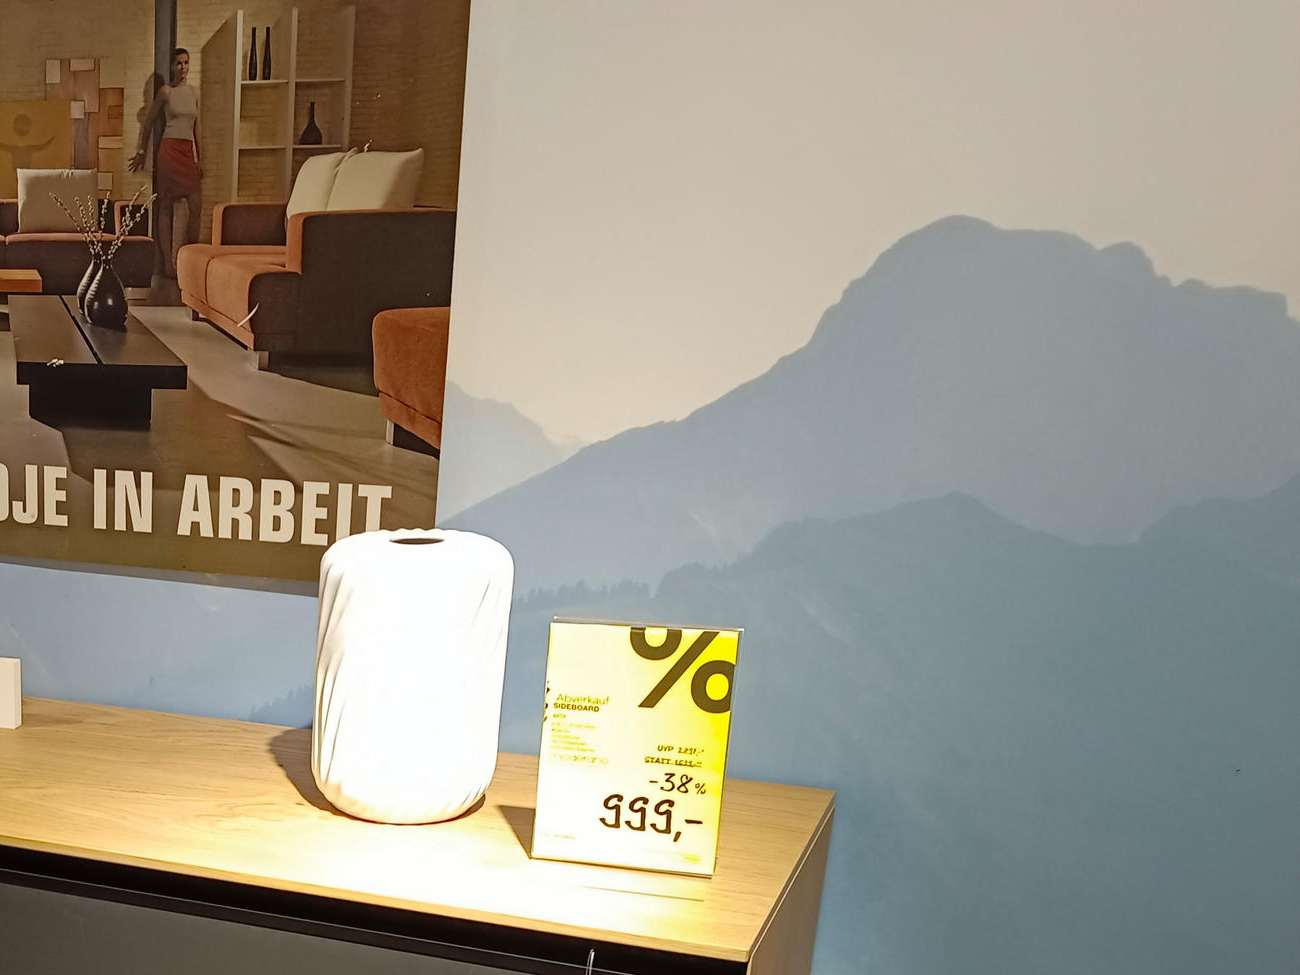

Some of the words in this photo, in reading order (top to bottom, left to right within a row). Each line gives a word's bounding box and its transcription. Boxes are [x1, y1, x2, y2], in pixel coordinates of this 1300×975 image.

[93, 468, 154, 534] IN
[176, 473, 393, 546] ARBEIT
[553, 702, 600, 713] SIDEBOARD
[556, 693, 610, 705] Abverkauf
[644, 756, 671, 765] STATT
[649, 772, 706, 795] -38%
[599, 794, 703, 842] 999,-
